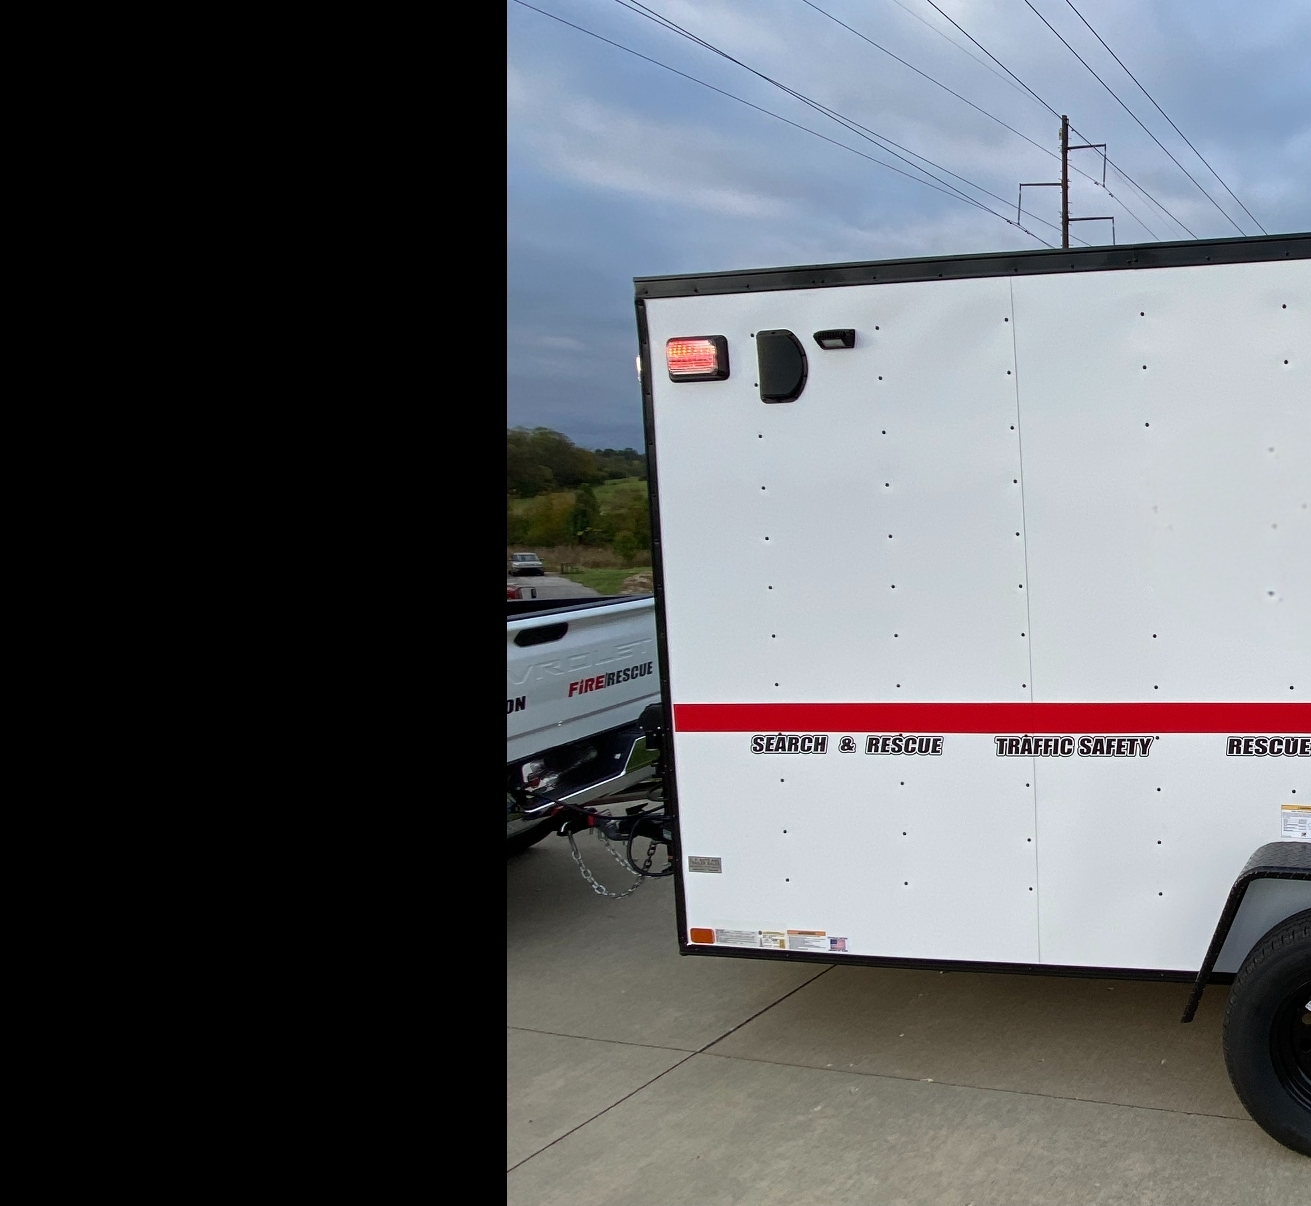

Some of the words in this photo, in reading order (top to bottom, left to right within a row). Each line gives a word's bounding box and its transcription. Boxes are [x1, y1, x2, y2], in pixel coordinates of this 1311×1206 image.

[751, 735, 828, 754] SEARCH
[839, 736, 856, 753] &
[865, 735, 944, 755] RESCUE
[994, 736, 1075, 757] TRAFFIC
[1078, 736, 1154, 757] SAFETY
